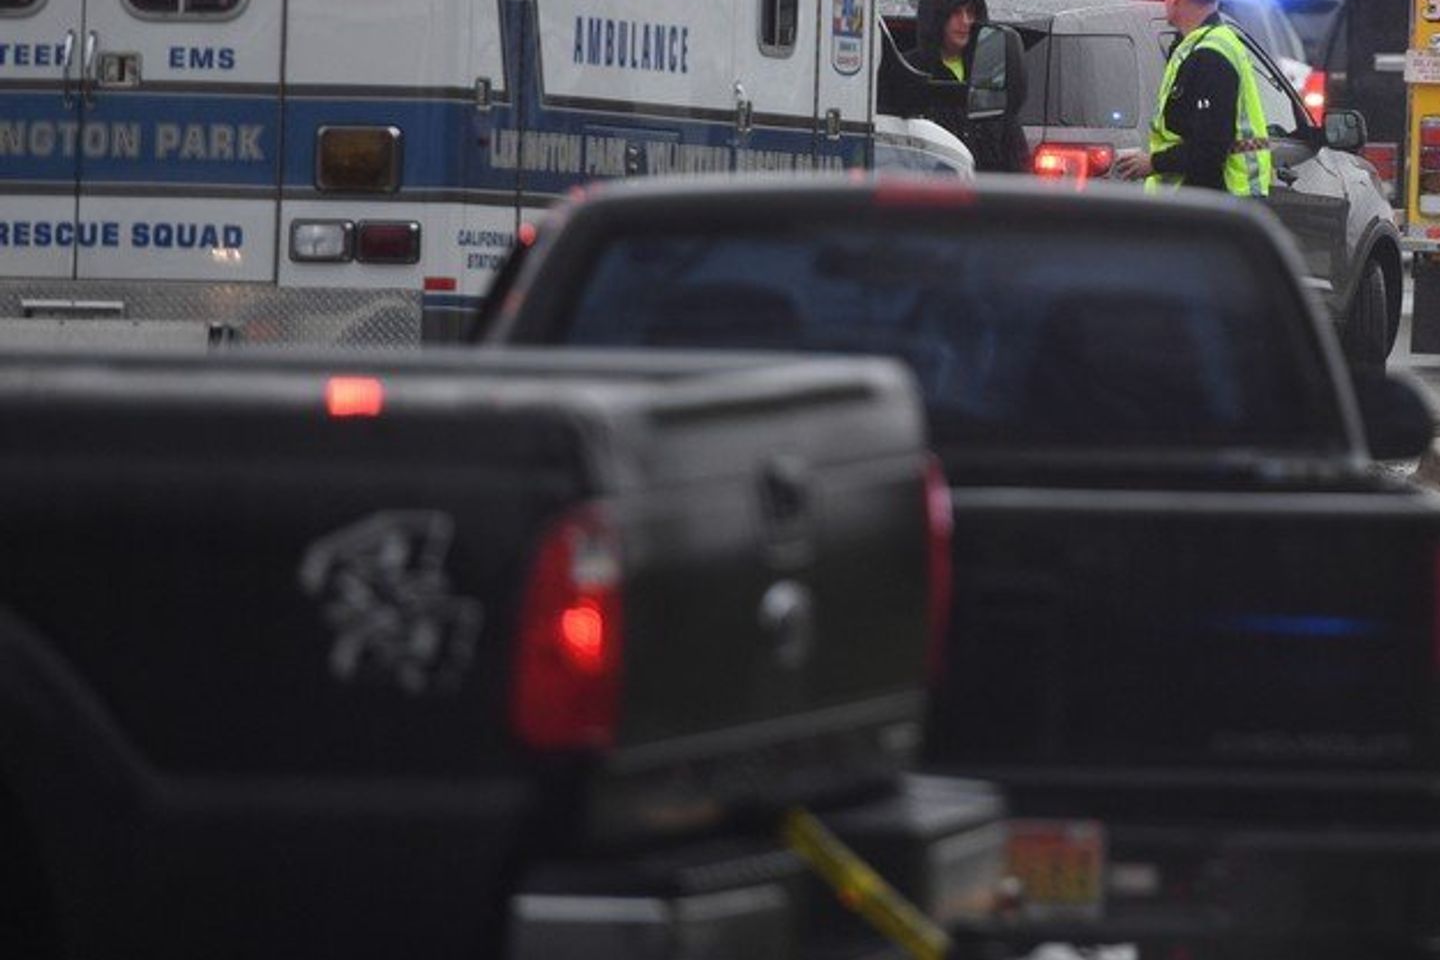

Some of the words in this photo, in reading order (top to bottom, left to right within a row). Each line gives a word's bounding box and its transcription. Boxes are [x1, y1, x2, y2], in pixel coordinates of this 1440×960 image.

[168, 47, 236, 70] EMS
[573, 16, 690, 74] AMBULANCE
[155, 122, 265, 162] PARK
[131, 222, 244, 249] SQUAD
